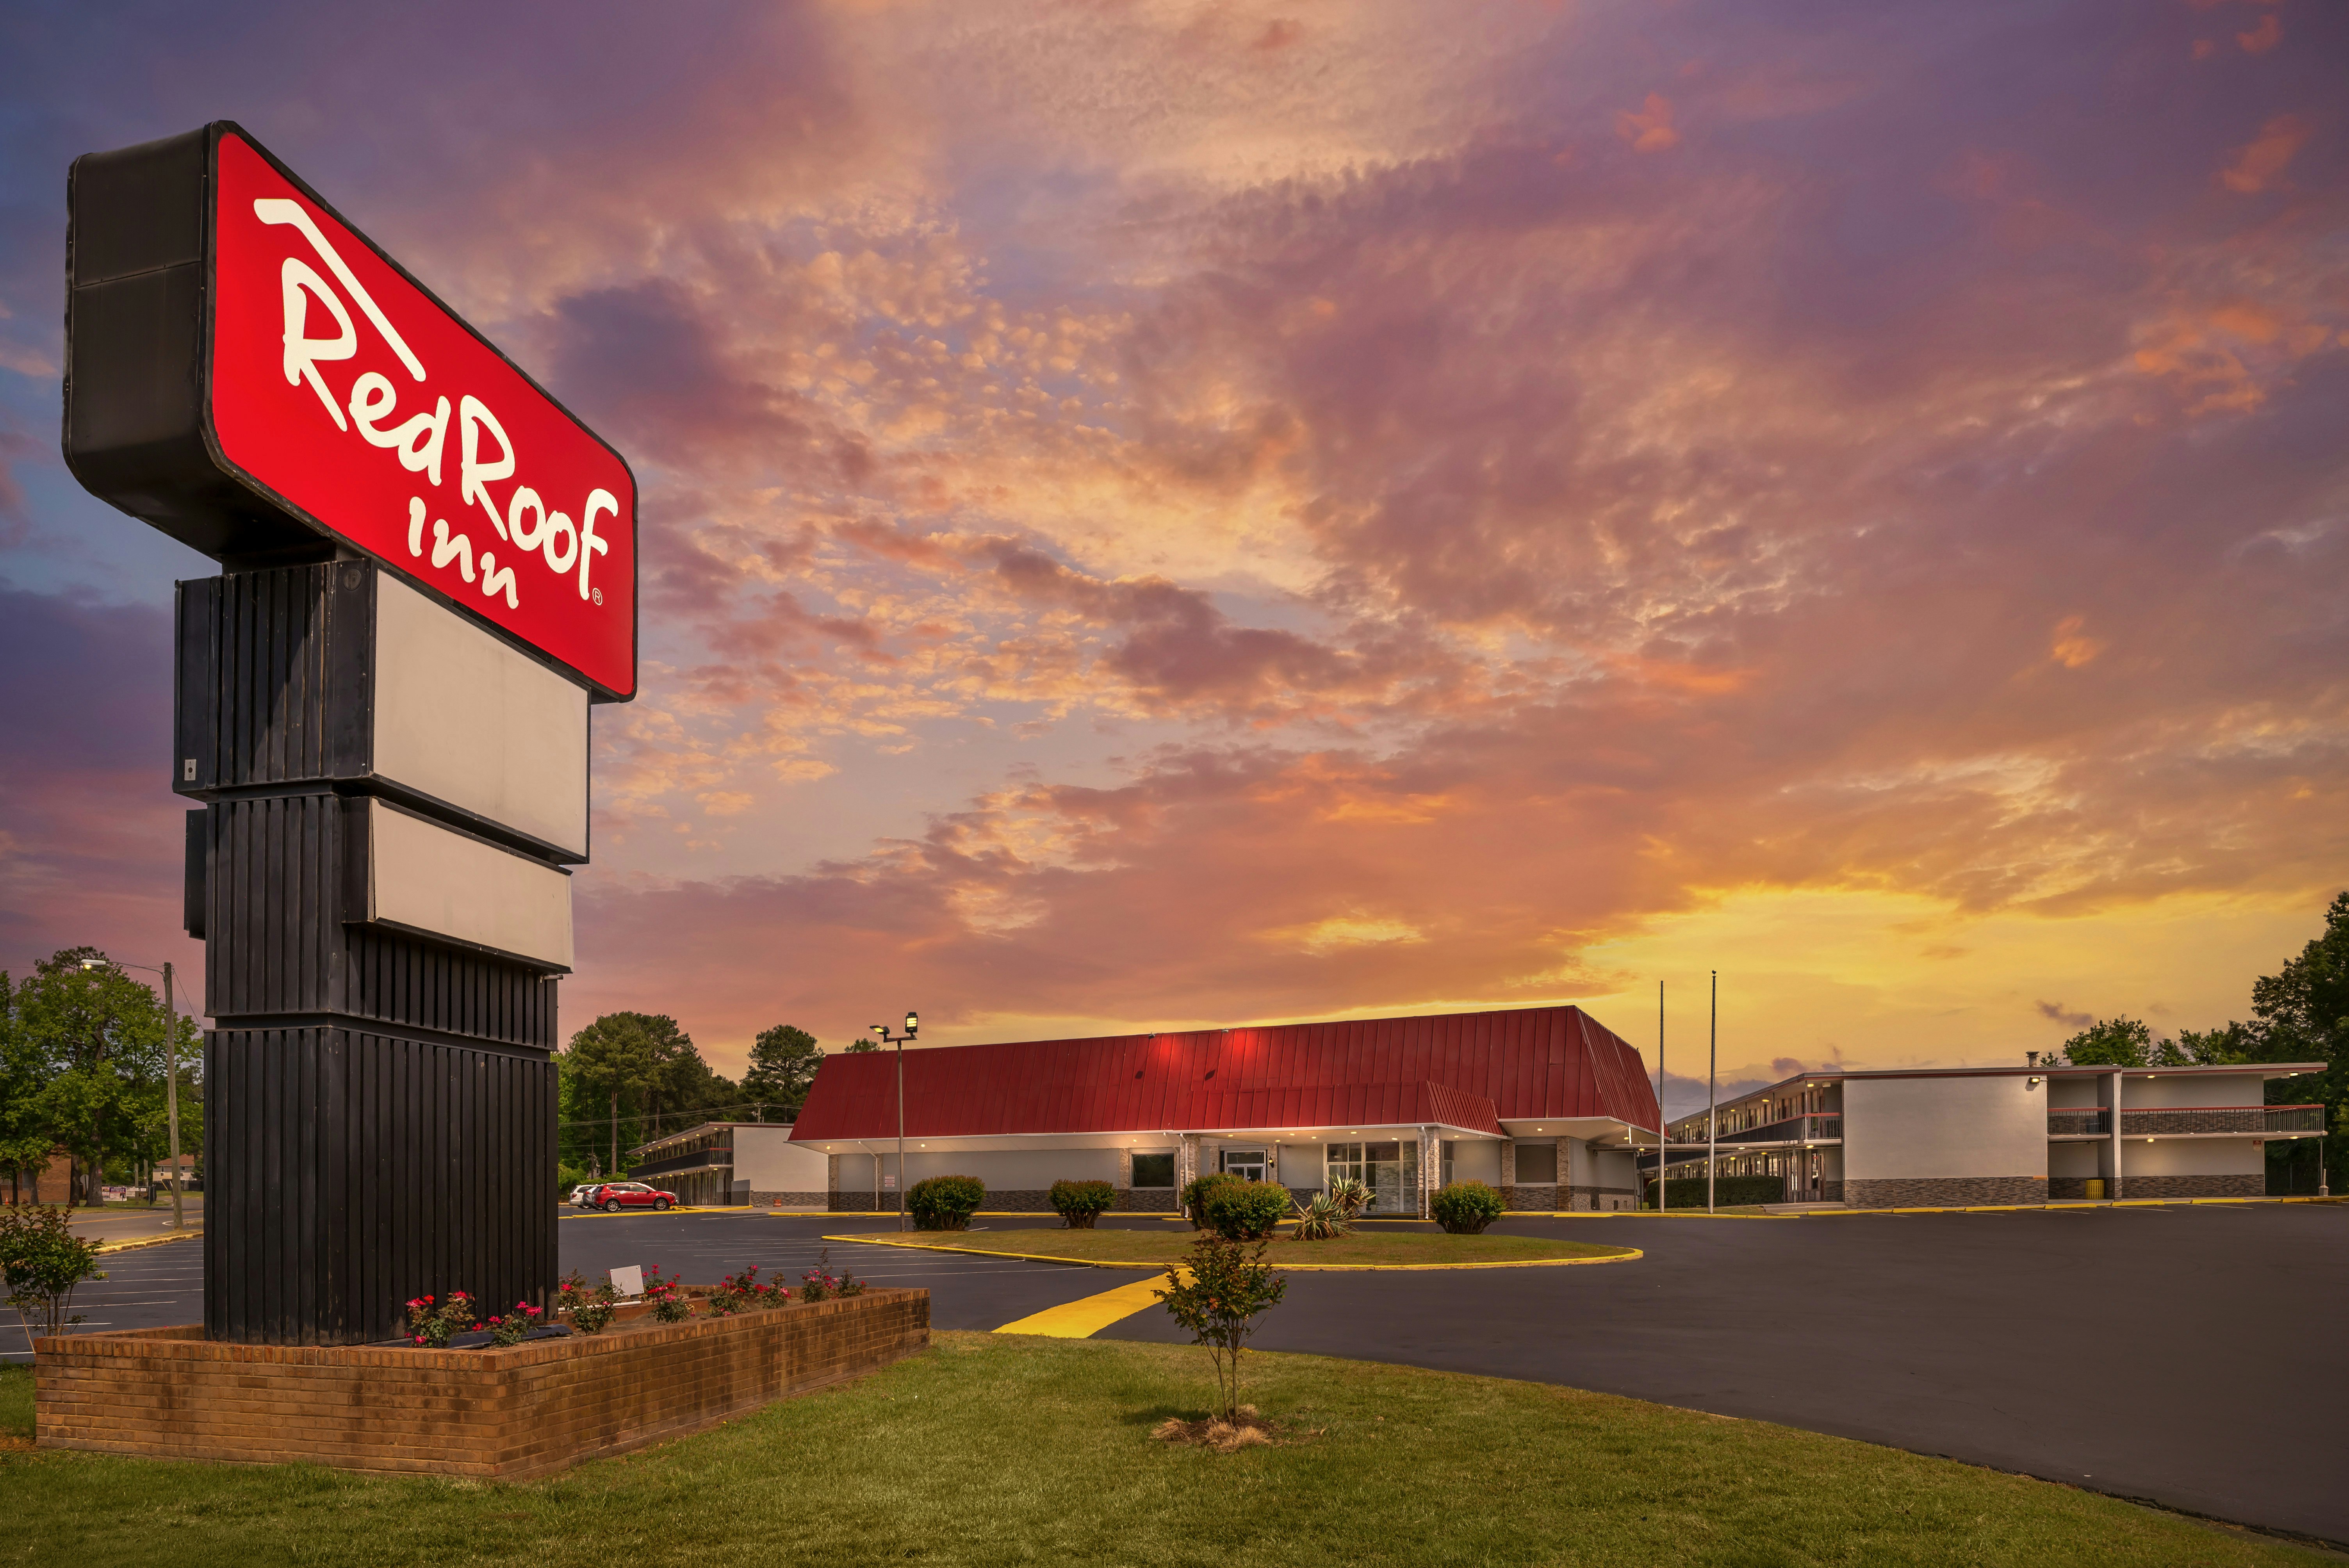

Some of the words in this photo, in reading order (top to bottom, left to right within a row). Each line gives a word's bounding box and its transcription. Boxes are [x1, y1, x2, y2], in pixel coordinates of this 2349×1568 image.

[281, 257, 452, 486] Red
[459, 394, 619, 600] Roof
[408, 495, 520, 609] Inn
